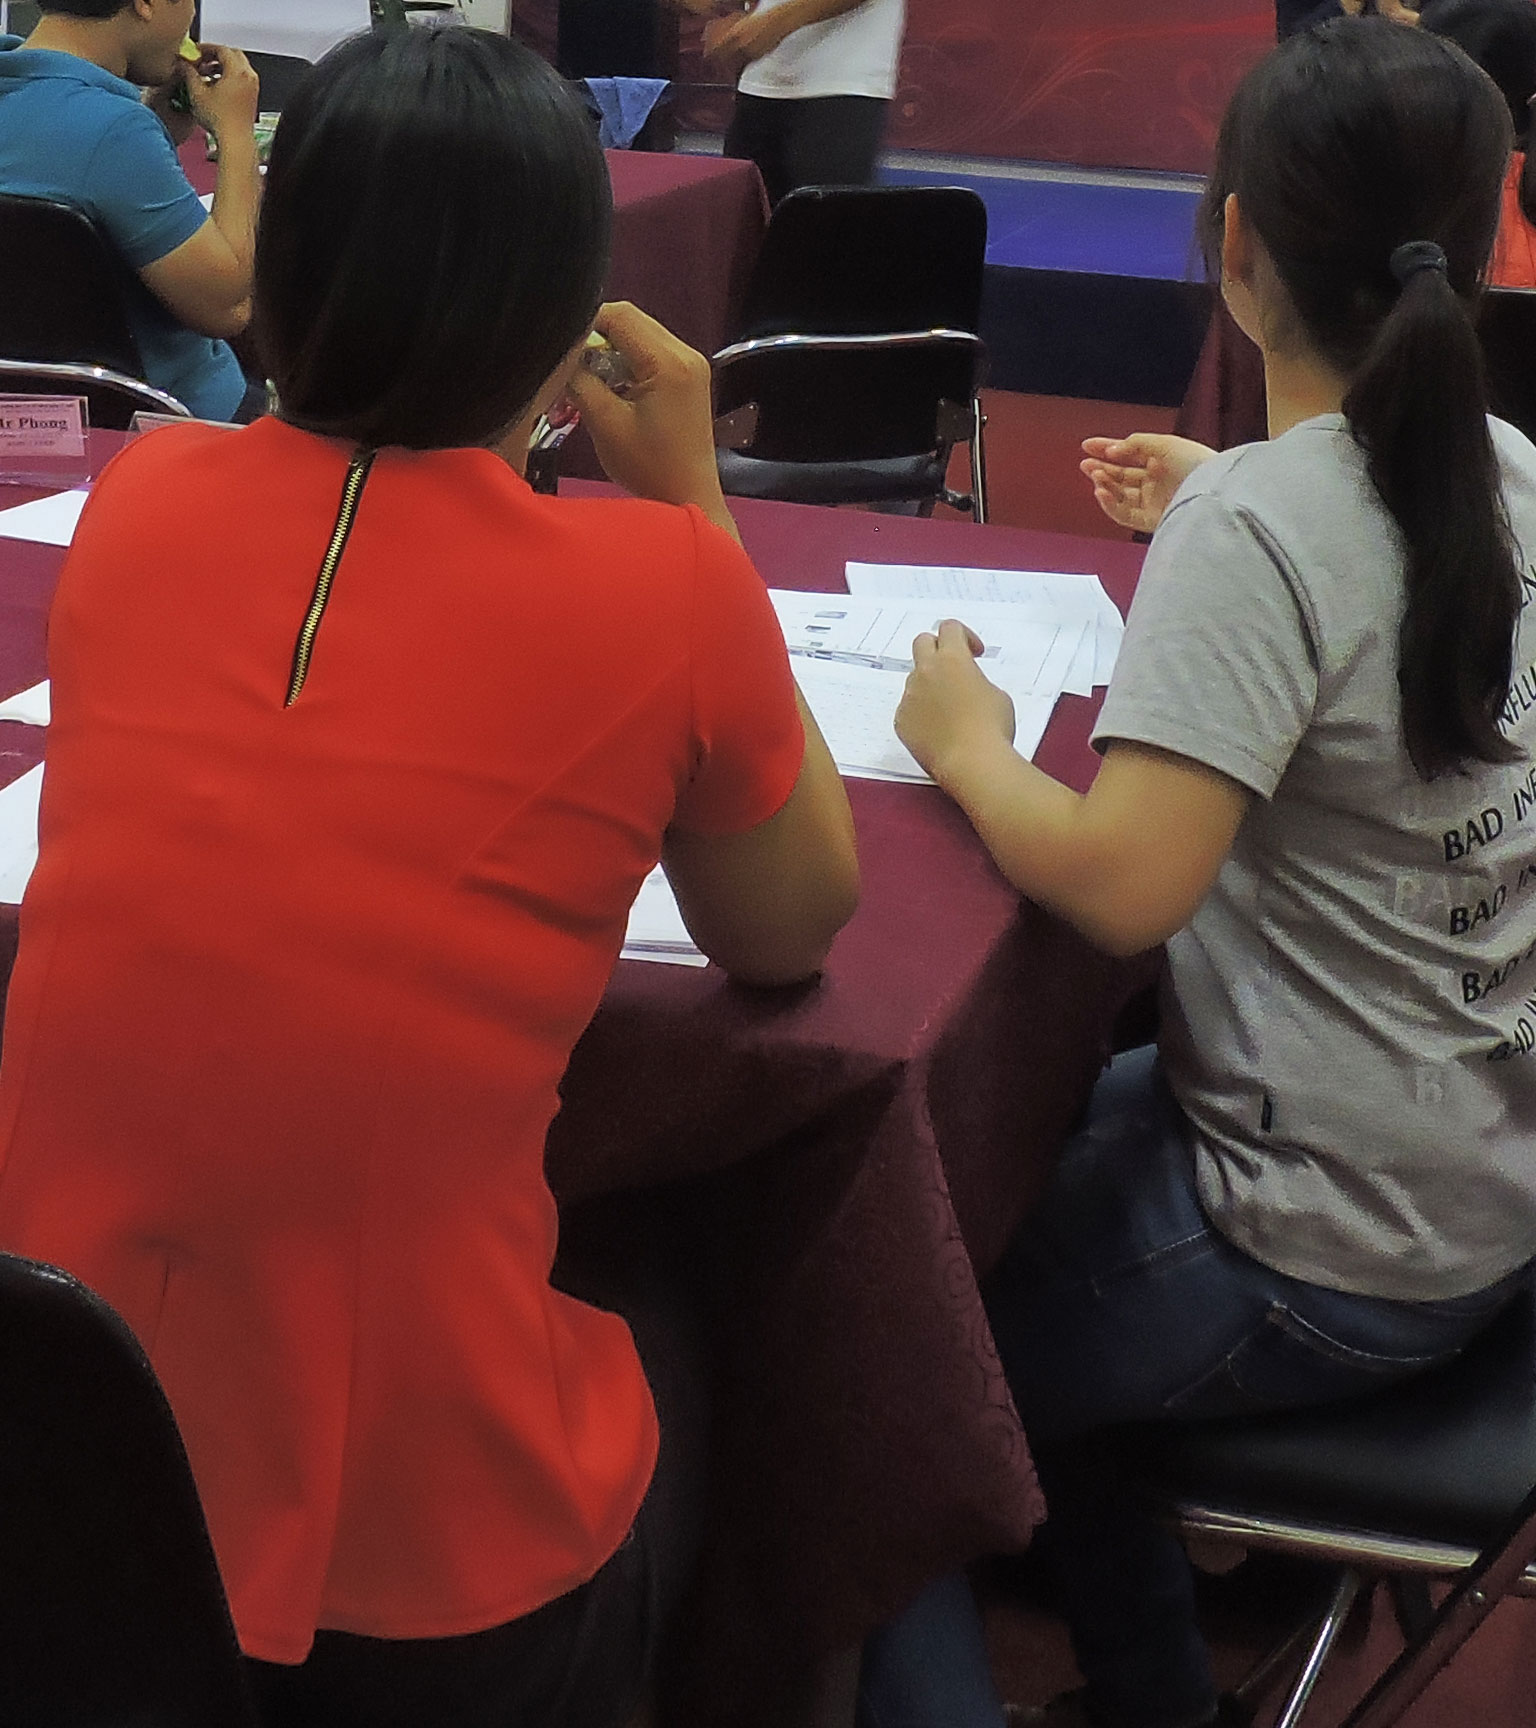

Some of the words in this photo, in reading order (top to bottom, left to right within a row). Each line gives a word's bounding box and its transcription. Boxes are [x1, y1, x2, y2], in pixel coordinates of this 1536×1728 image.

[19, 416, 68, 432] Phong
[1443, 807, 1504, 863] BAD
[1450, 883, 1507, 936] BAD
